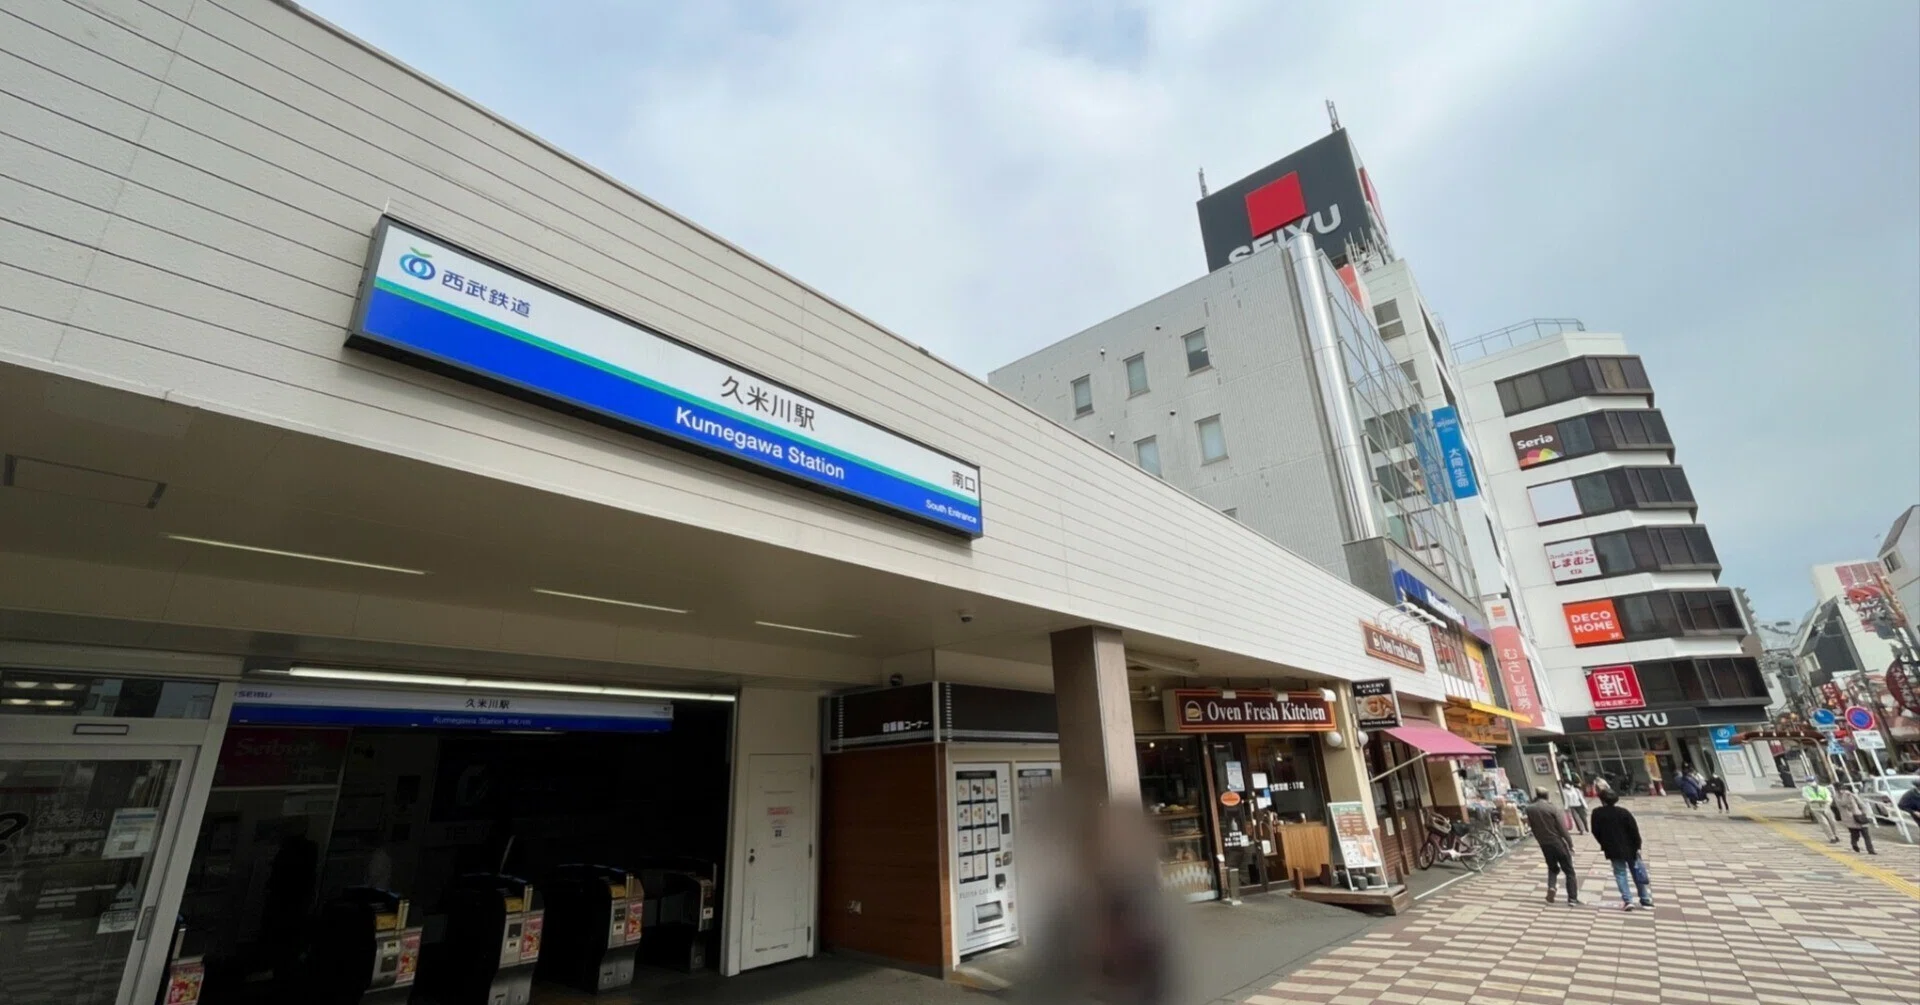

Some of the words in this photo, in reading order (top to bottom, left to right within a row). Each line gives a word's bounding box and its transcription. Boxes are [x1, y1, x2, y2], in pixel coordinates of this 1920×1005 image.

[441, 269, 531, 318] 西武鉄道
[720, 375, 815, 431] 久米川駅
[675, 406, 784, 459] Kumegawa
[787, 446, 845, 481] Station
[1516, 434, 1554, 450] Seria
[1448, 447, 1469, 488] 大同生命
[951, 470, 976, 493] 南口
[925, 498, 947, 515] South
[947, 506, 977, 524] Entrance
[1551, 554, 1595, 569] しまむら
[1570, 610, 1611, 624] DECO
[1573, 620, 1615, 634] HOME
[1356, 682, 1385, 690] BAKERY
[1503, 648, 1533, 710] むさし証券
[1596, 673, 1629, 697] 靴
[464, 697, 510, 709] 久米川駅
[1207, 701, 1242, 721] Oven
[1244, 702, 1279, 721] Fresh
[1281, 702, 1327, 721] Kitchen
[1604, 712, 1669, 729] SEIYU
